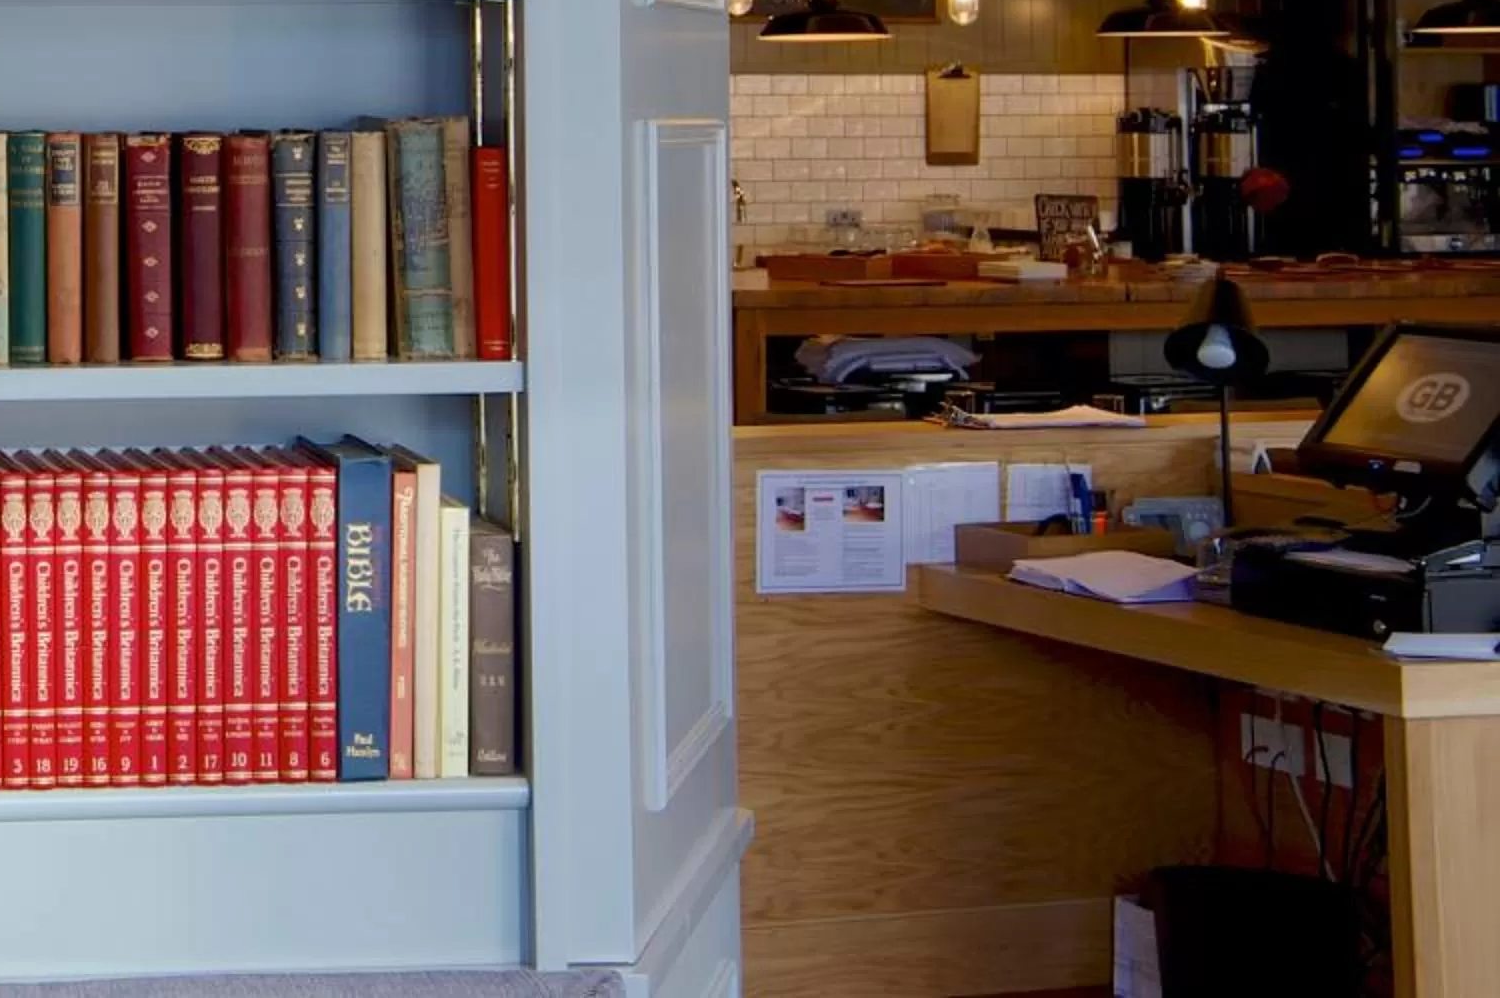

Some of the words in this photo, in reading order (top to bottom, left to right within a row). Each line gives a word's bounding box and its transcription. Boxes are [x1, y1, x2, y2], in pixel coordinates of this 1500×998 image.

[9, 561, 24, 630] Children's
[36, 561, 51, 630] Children's
[63, 560, 79, 629] Children's
[91, 559, 107, 628] Children's
[119, 559, 134, 629] Children's
[148, 559, 163, 626] Children's
[176, 558, 192, 627] Children's
[205, 558, 220, 627] Children's
[232, 557, 247, 624] Children's
[259, 557, 274, 624] Children's
[286, 556, 302, 624] Children's
[317, 555, 332, 623] Children's
[346, 522, 373, 613] BIBLE
[11, 632, 25, 702] Britannica
[37, 631, 52, 701] Britannica
[64, 631, 79, 700] Britannica
[91, 630, 107, 699] Britannica
[120, 630, 135, 699] Britannica
[148, 629, 163, 699] Britannica
[176, 628, 192, 698] Britannica
[205, 628, 220, 698] Britannica
[232, 627, 247, 697] Britannica
[260, 627, 275, 697] Britannica
[287, 626, 302, 696] Britannica
[317, 626, 332, 696] Britannica
[36, 759, 51, 773] 18
[64, 757, 79, 772] 19
[120, 756, 131, 771] 9
[150, 755, 158, 770] 1
[177, 755, 188, 770] 2
[204, 754, 218, 769] 17
[232, 753, 247, 767] 10
[260, 753, 273, 767] 11
[289, 752, 299, 766] 8
[320, 752, 331, 767] 6
